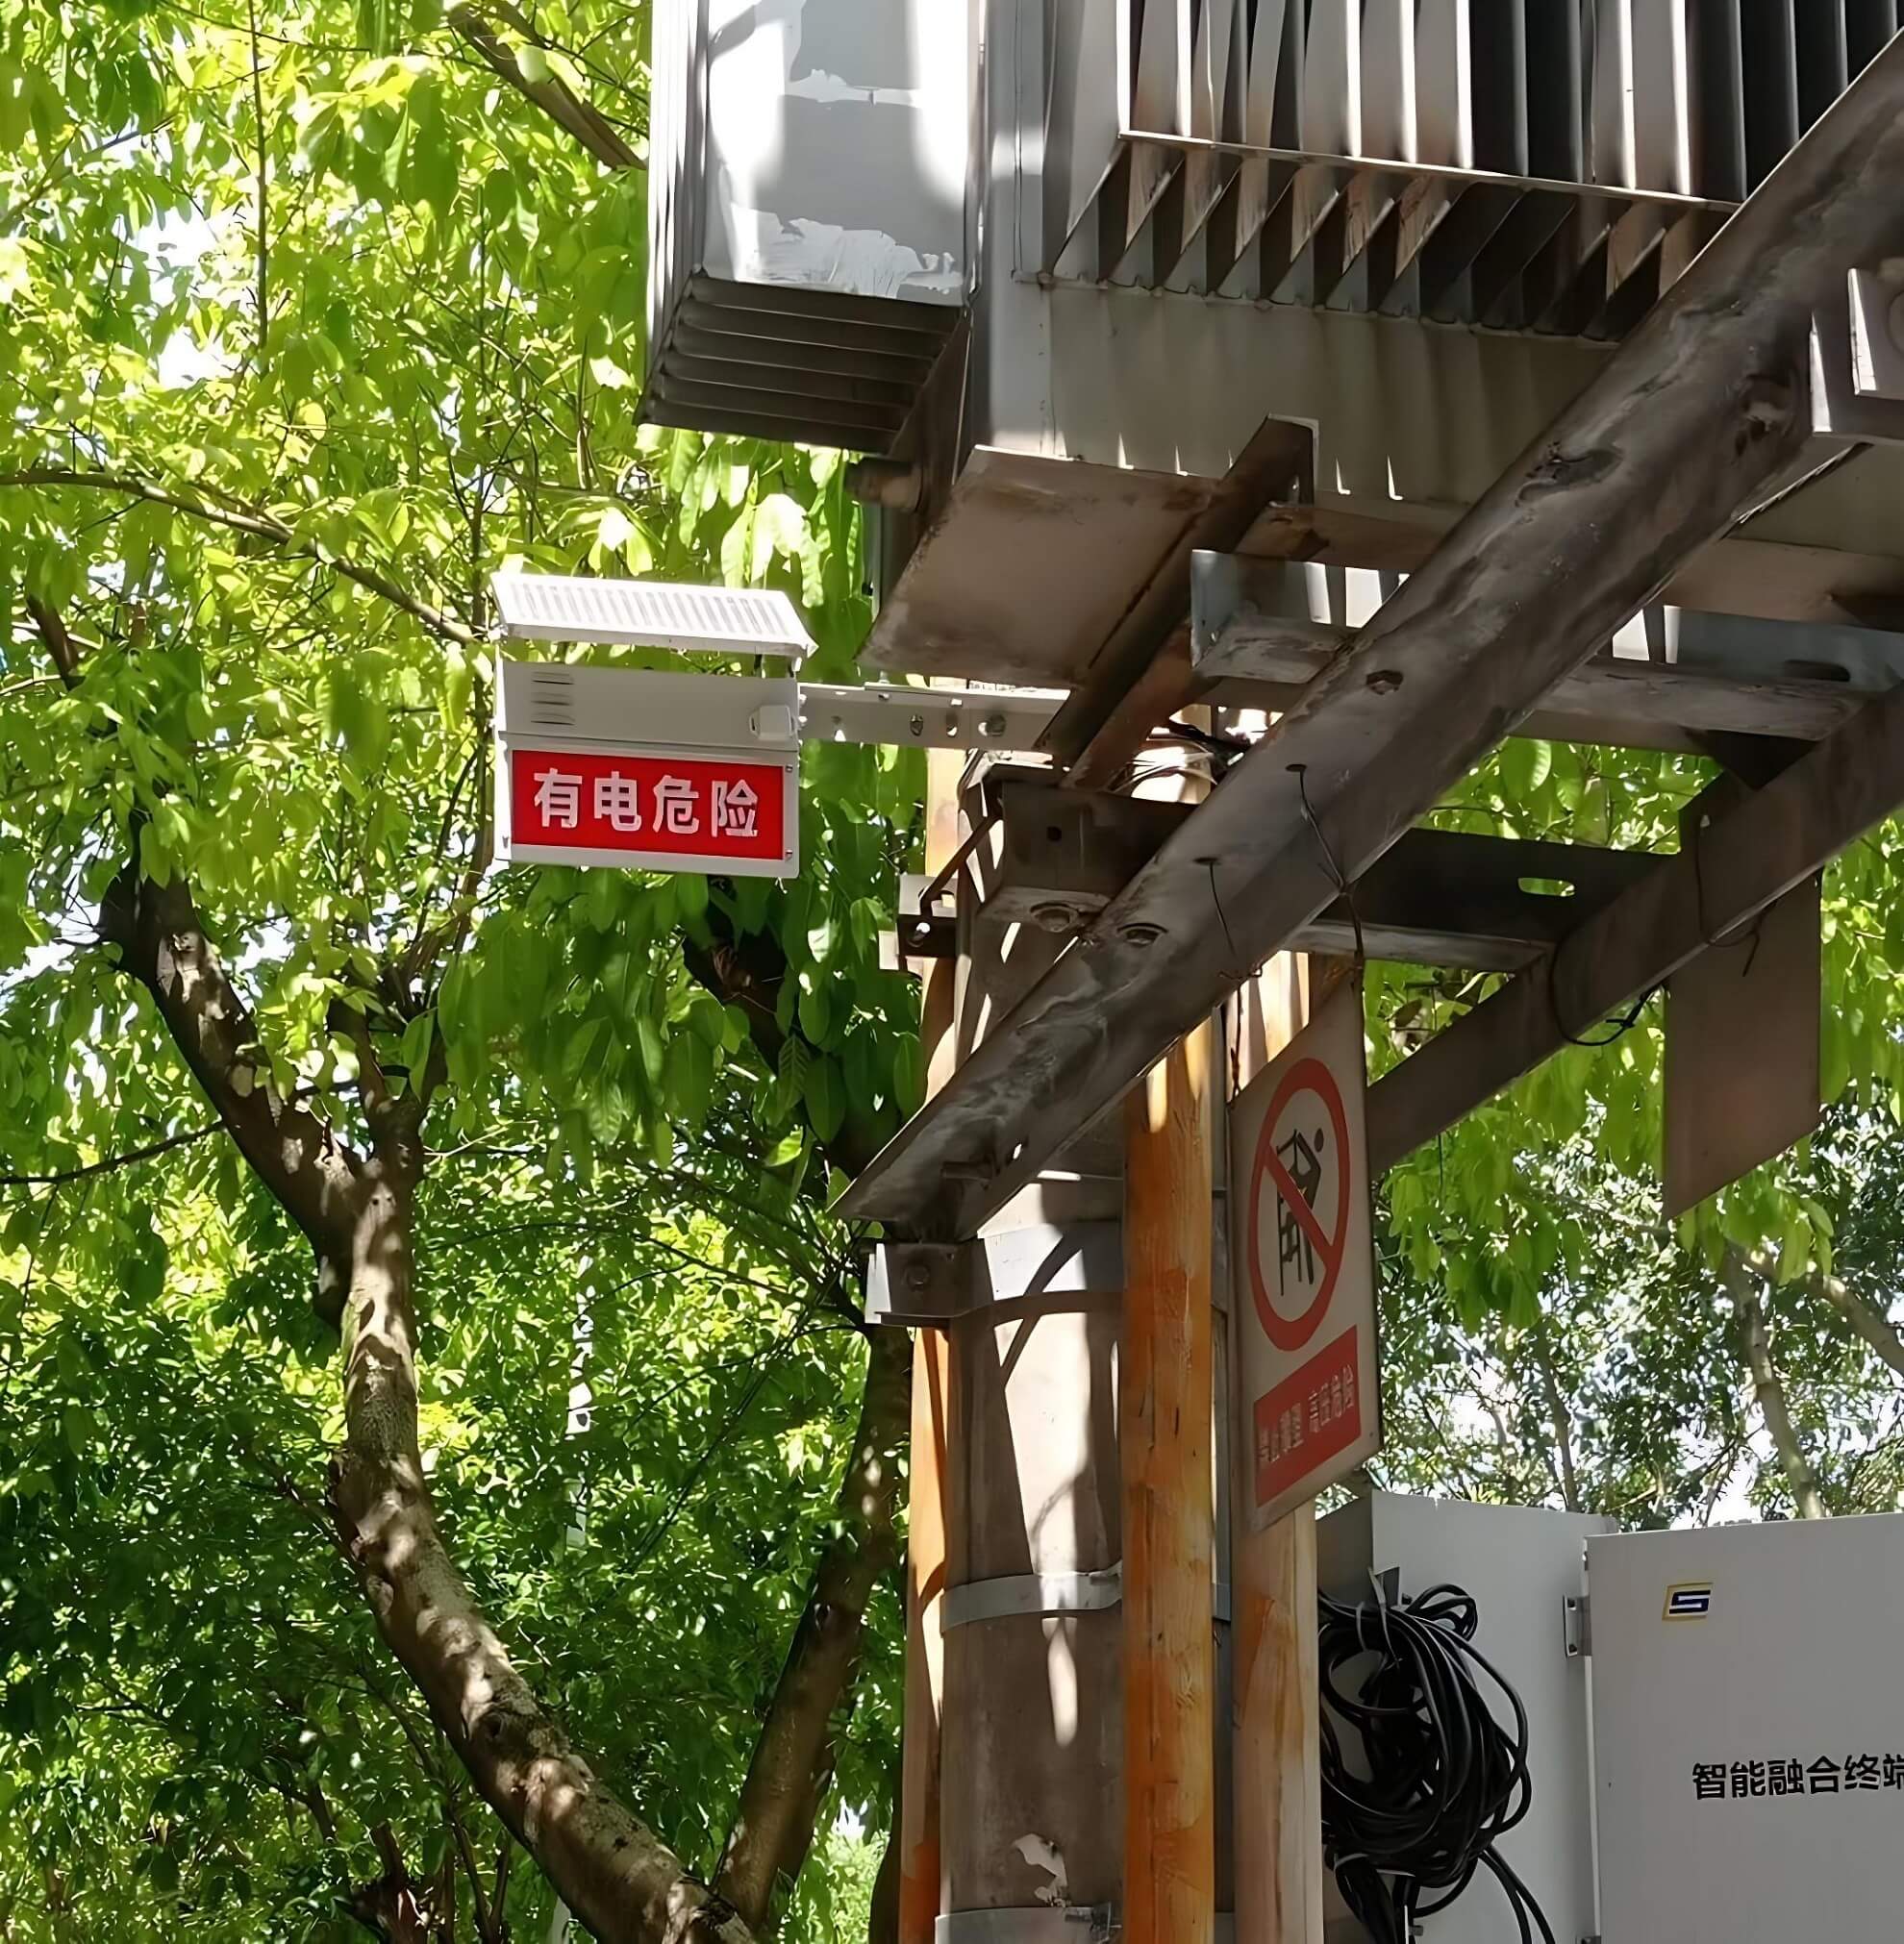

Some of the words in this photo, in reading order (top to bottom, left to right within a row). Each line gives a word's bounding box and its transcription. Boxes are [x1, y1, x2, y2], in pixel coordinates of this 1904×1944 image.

[534, 767, 759, 837] 有电危险
[1692, 1754, 1904, 1800] 智能融合终端
